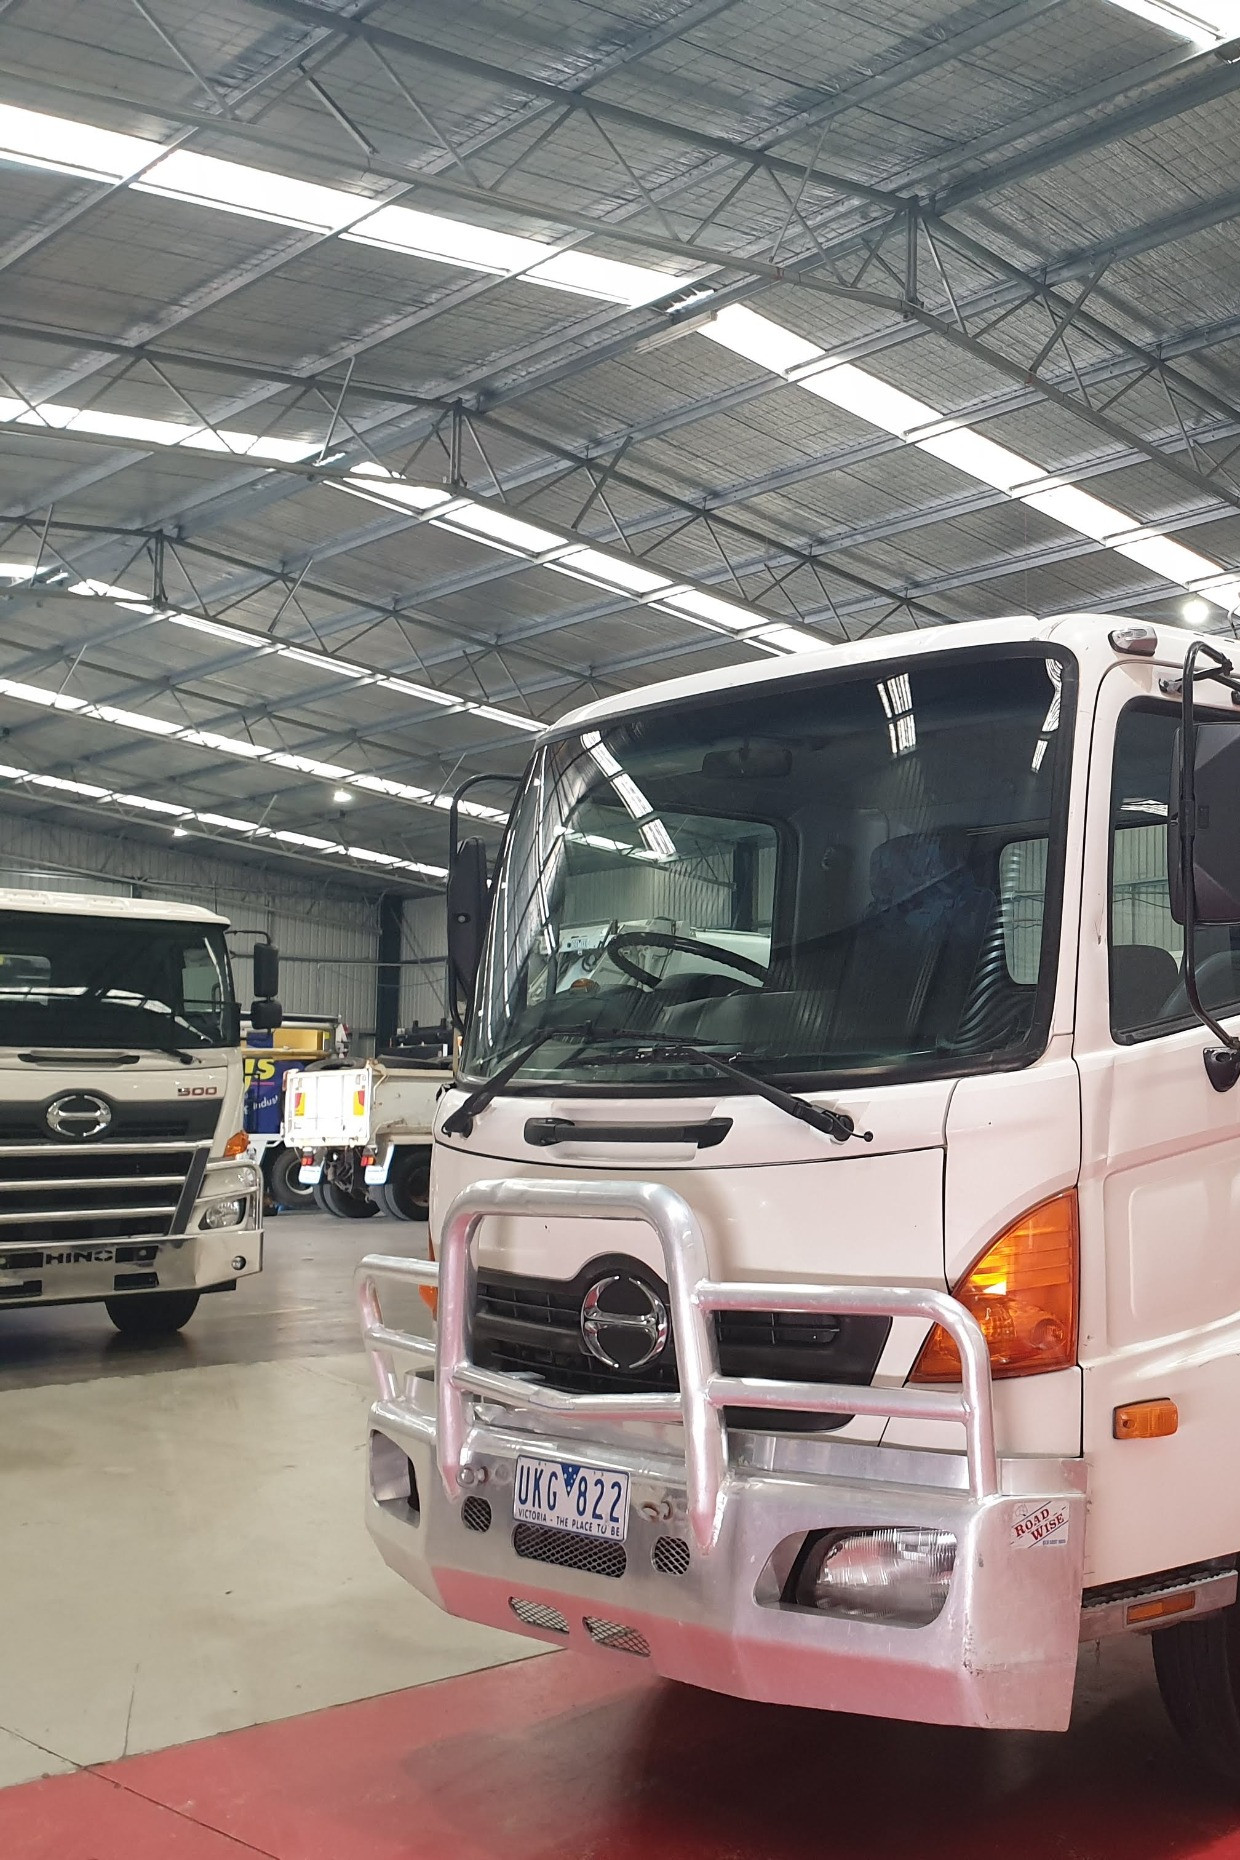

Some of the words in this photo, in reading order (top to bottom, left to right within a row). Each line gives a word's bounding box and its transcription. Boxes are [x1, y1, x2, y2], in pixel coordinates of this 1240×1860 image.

[178, 1087, 217, 1096] 500
[45, 1250, 113, 1265] HINO
[518, 1464, 558, 1511] UKG
[576, 1476, 622, 1523] 822
[518, 1507, 547, 1523] VICTORIA
[556, 1516, 568, 1528] THE
[572, 1519, 592, 1532] PLACE
[597, 1523, 607, 1535] TO
[611, 1526, 620, 1537] BE
[1013, 1508, 1050, 1538] ROAD
[1030, 1513, 1064, 1541] WISE
